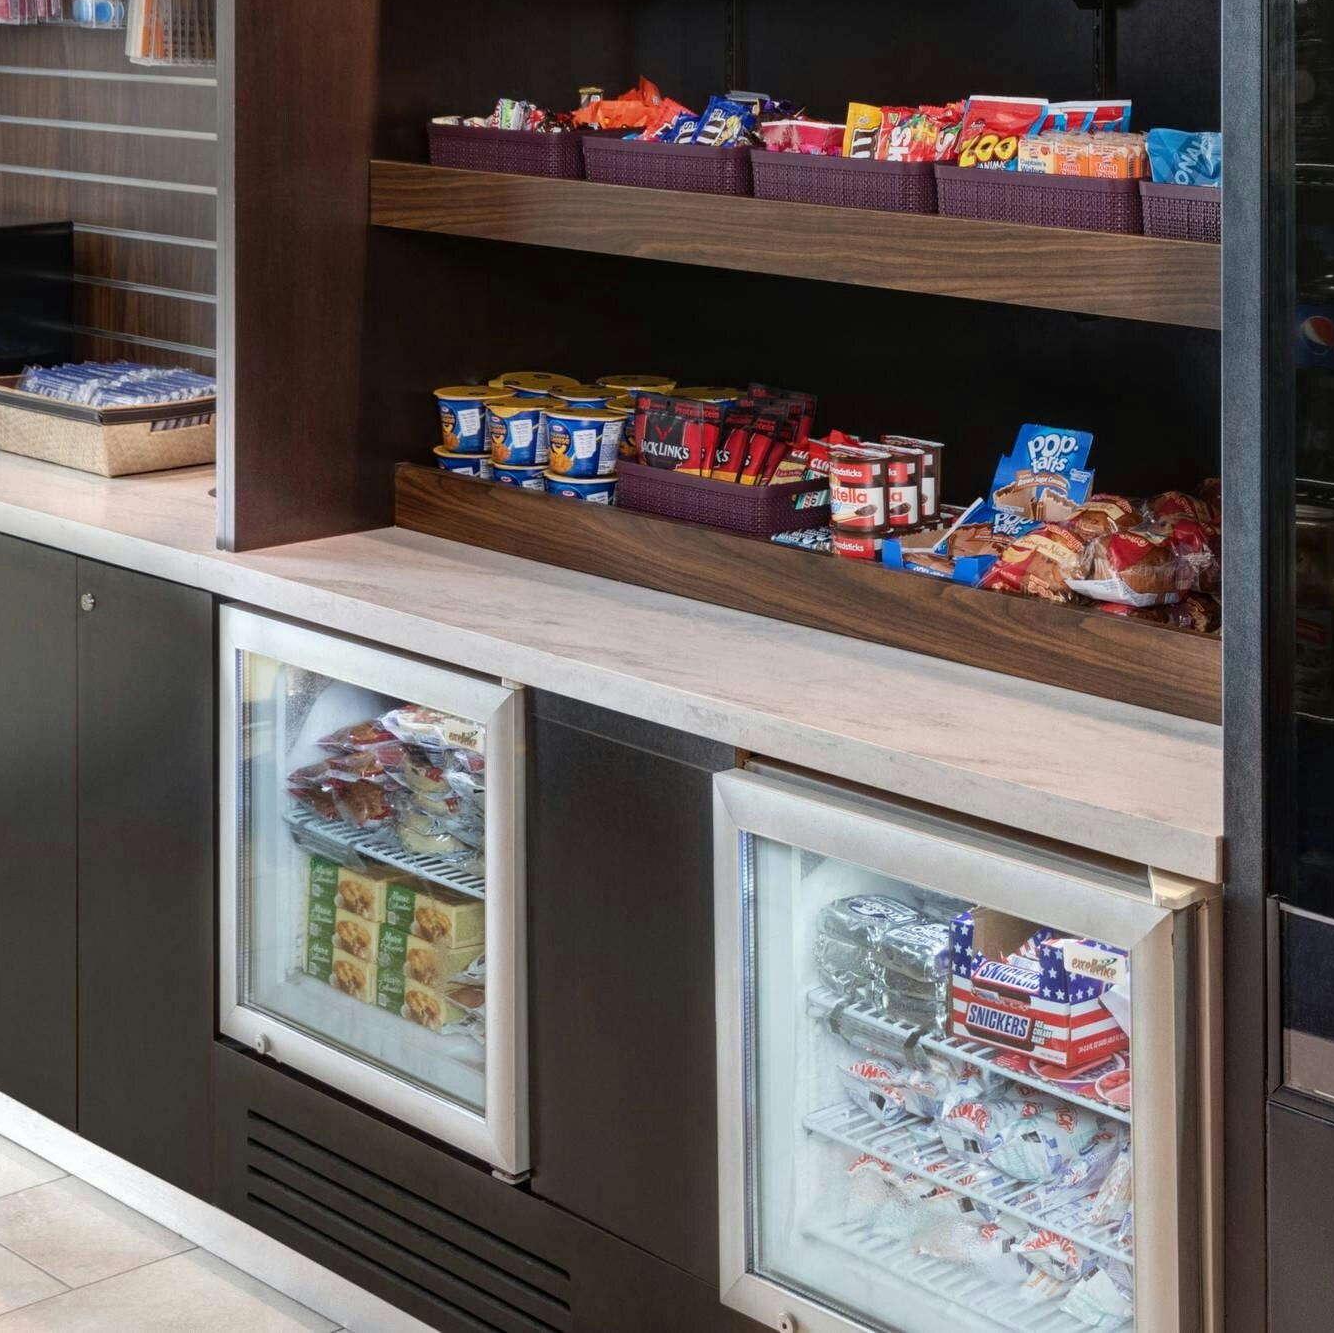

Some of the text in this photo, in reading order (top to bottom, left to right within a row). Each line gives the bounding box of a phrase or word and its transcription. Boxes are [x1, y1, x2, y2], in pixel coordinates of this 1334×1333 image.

[958, 133, 1020, 168] ZOO
[831, 487, 869, 504] utella
[967, 1002, 1029, 1038] SNICKERS
